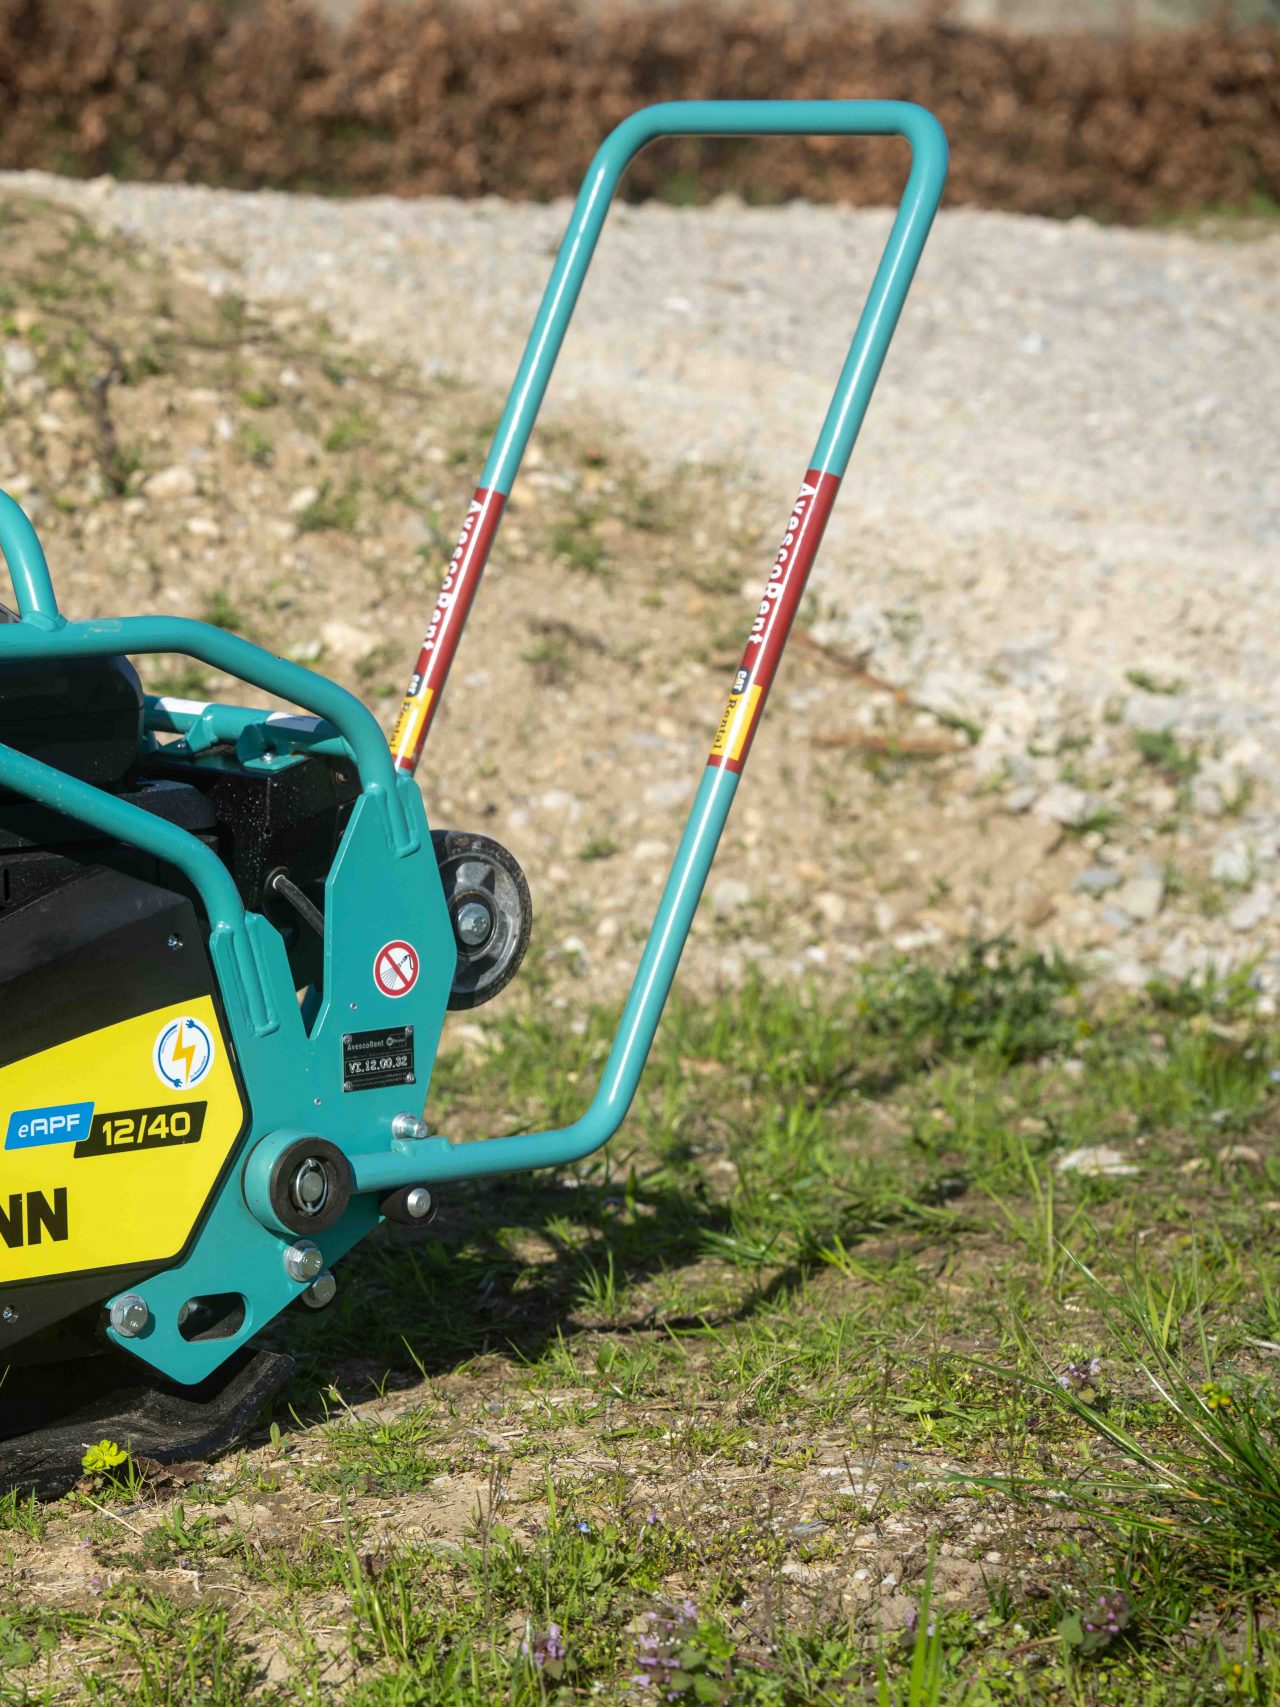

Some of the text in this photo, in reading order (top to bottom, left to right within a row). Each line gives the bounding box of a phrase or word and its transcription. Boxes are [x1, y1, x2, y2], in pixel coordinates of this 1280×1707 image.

[423, 499, 483, 651] AvescoRent
[749, 482, 815, 645] AvescoRent
[733, 670, 747, 692] CAT
[712, 698, 738, 750] Rental
[347, 1040, 384, 1051] AvescoRent
[18, 1111, 191, 1146] eAPF 12/40
